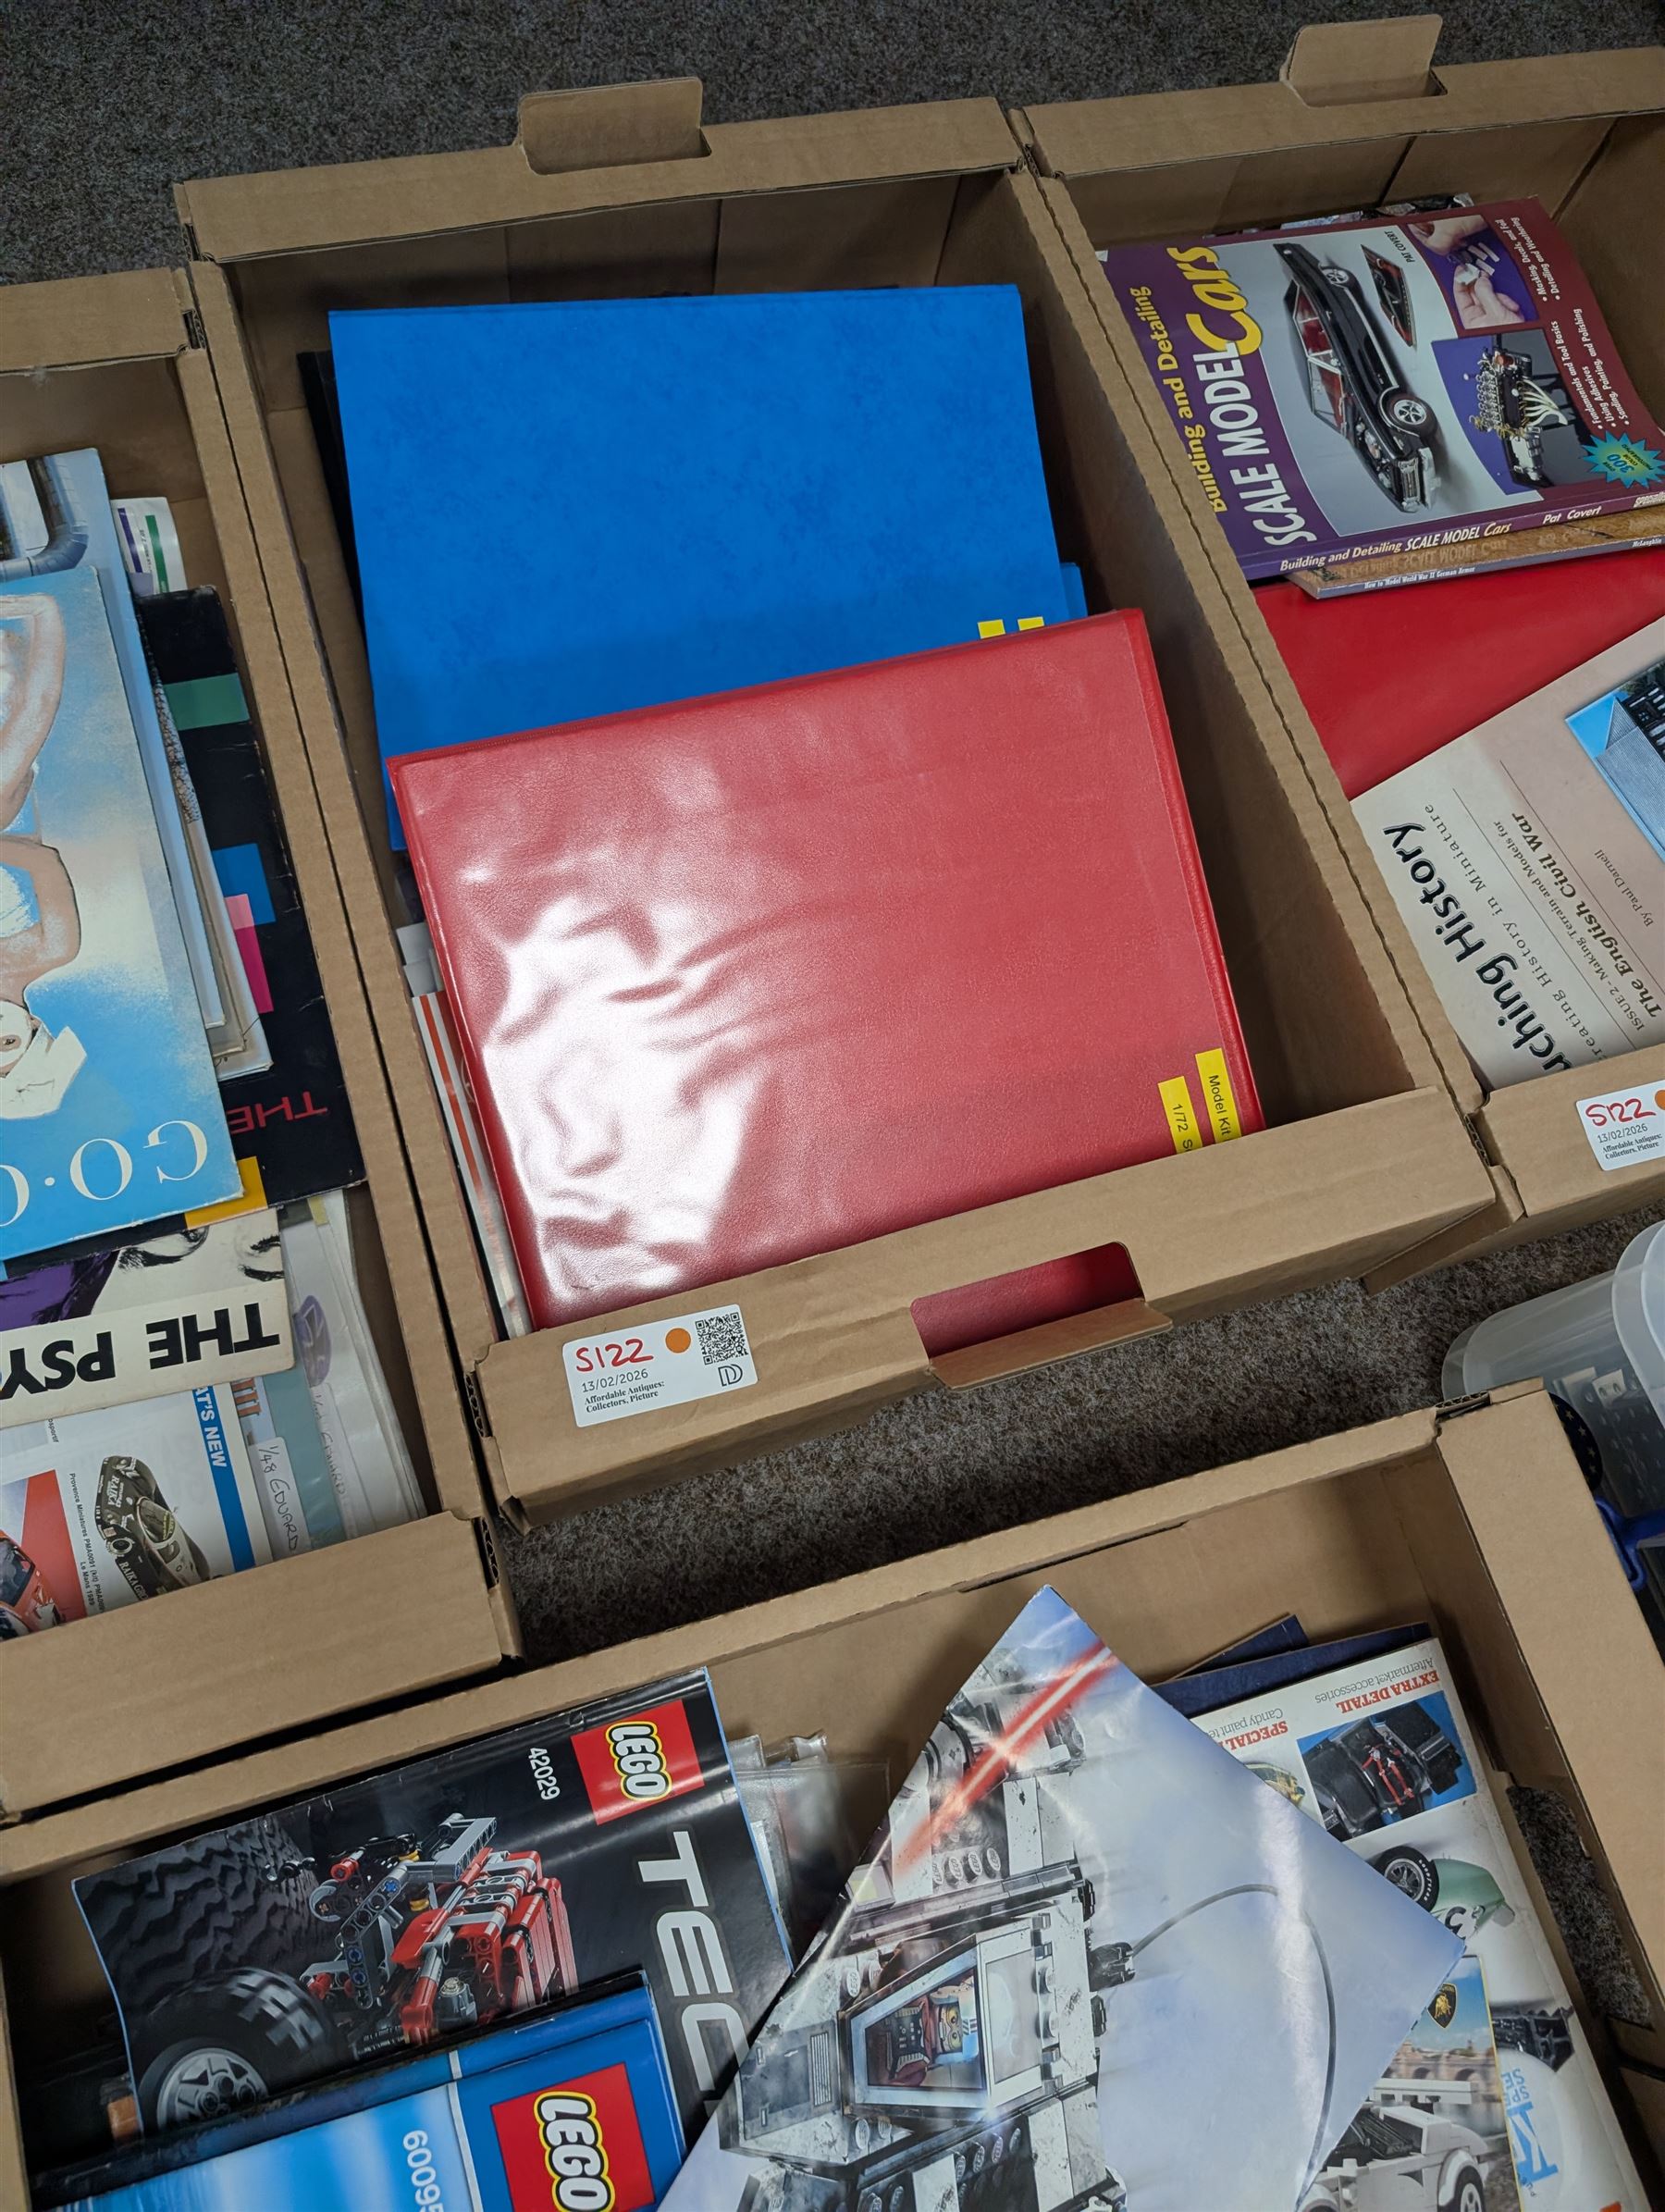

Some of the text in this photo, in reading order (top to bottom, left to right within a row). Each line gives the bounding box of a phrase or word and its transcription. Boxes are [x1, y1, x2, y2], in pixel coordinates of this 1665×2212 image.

[1503, 229, 1517, 241] and
[1511, 216, 1560, 294] Detailing and Weathering
[1573, 308, 1591, 342] Polishing
[1584, 343, 1597, 357] and
[1551, 321, 1602, 425] Fundamentals and Tool Basics
[1130, 286, 1227, 513] Building and Detailing
[1166, 246, 1317, 546] SCALE MODEL Cars
[1582, 365, 1615, 422] Using Adhesives
[1607, 454, 1634, 473] 300
[1279, 506, 1602, 572] Building and Detailing SCALE MODEL Cars Pat Covert
[1632, 538, 1663, 549] McLaughlin
[1418, 573, 1429, 582] War
[1437, 569, 1457, 579] German
[1493, 821, 1508, 838] for
[1505, 835, 1536, 879] Models
[1383, 822, 1486, 963] History
[1532, 877, 1552, 898] and
[1595, 849, 1655, 928] By Paul Darnell
[1424, 803, 1609, 1060] reating History in Miniature
[1511, 812, 1663, 1018] The English Civil War
[1548, 896, 1580, 940] Terrain
[1576, 937, 1608, 981] Making
[1609, 986, 1620, 997] 2
[1615, 994, 1646, 1032] ISSUE
[228, 1092, 327, 1134] THE
[1172, 1104, 1189, 1132] 1/72
[1208, 1075, 1231, 1136] Model Kit
[1585, 1098, 1657, 1126] S122
[1597, 1123, 1648, 1143] 13/02/2026
[1603, 1133, 1663, 1153] Affordable Antiques:
[1605, 1142, 1659, 1160] Collectors, Picture
[145, 1303, 280, 1370] THE
[575, 1338, 654, 1372] S122
[582, 1368, 648, 1393] 13/02/2026
[584, 1380, 665, 1405] Affordable Antiques:
[586, 1390, 659, 1413] Collectors, Picture
[204, 1429, 228, 1468] NEW
[69, 1473, 80, 1503] Provence
[77, 1504, 88, 1537] Miniatures
[258, 1445, 299, 1551] 1/48 EDUARD
[80, 1562, 87, 1571] Le
[82, 1572, 91, 1589] Mans
[1315, 1657, 1433, 1704] Aftermarket accessories
[1336, 1670, 1440, 1713] EXTRA DETAIL
[1222, 1716, 1247, 1737] paint
[1230, 1721, 1289, 1750] SPECIAL
[1243, 1708, 1283, 1731] Candy
[528, 1747, 561, 1800] 42029
[609, 1724, 669, 1798] LEGO
[536, 2094, 613, 2212] LEGO
